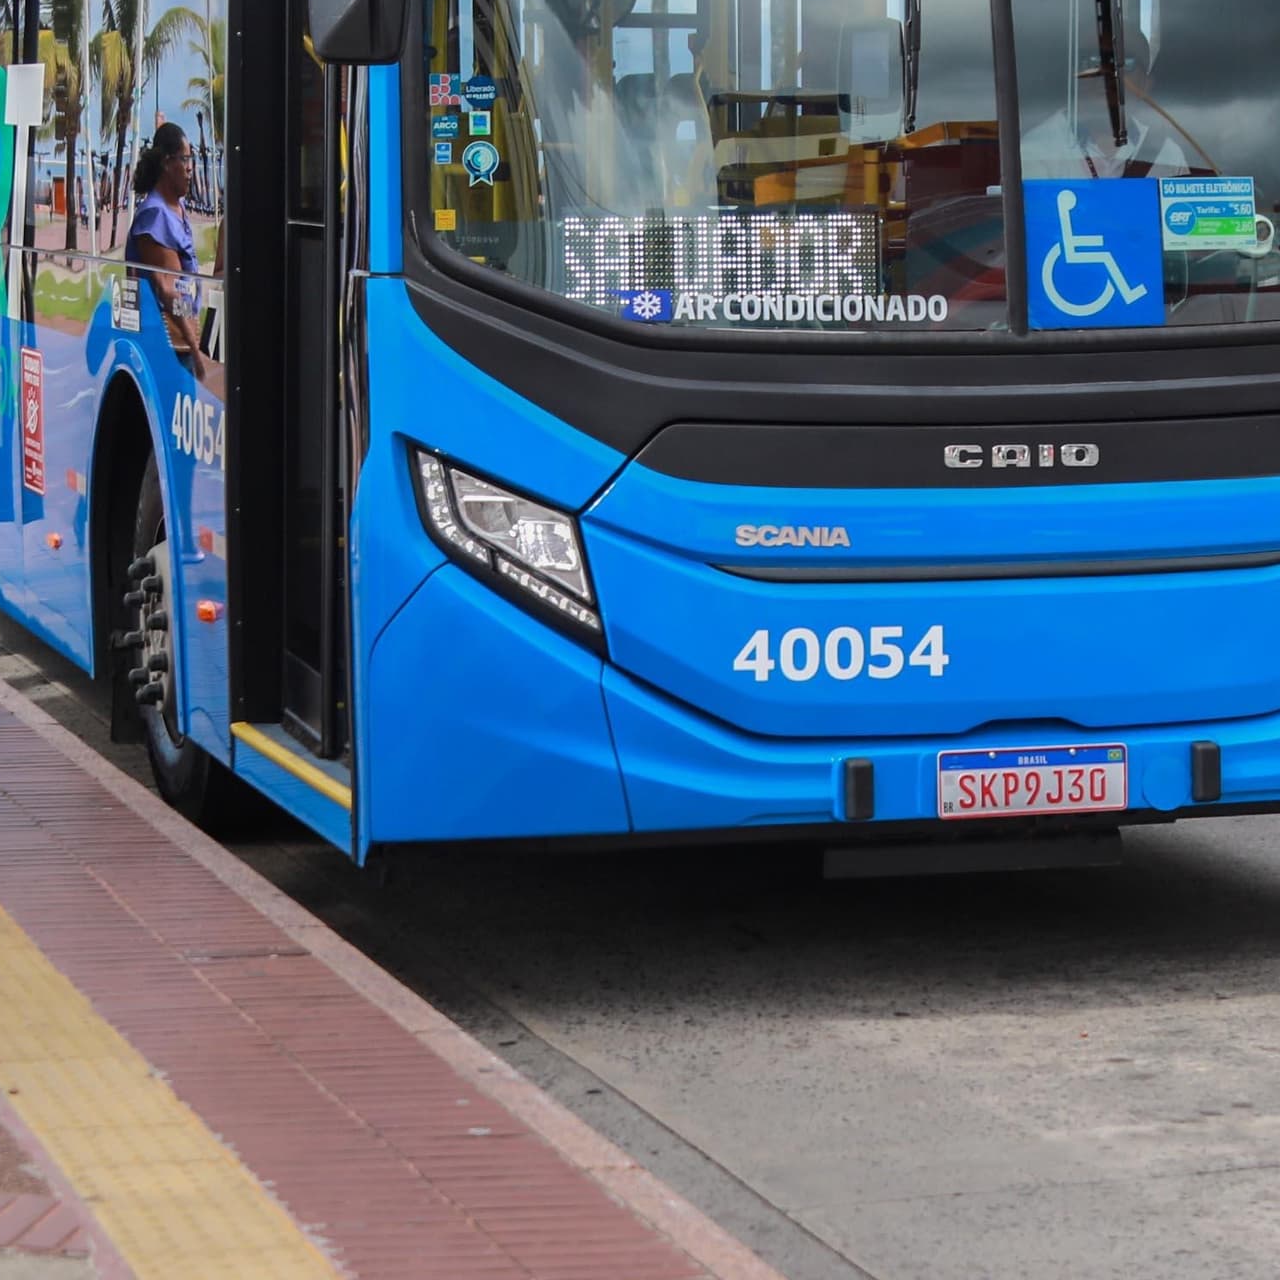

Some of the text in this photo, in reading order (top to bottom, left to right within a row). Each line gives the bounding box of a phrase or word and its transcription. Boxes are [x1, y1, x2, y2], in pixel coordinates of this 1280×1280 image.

[674, 295, 948, 321] AR CONDICIONADO
[171, 392, 226, 471] 40054
[944, 443, 1100, 468] CAIO
[734, 524, 851, 548] SCANIA
[732, 624, 950, 682] 40054
[1017, 755, 1049, 766] BRASIL
[959, 767, 1106, 809] SKP9J30
[943, 802, 954, 814] BR
